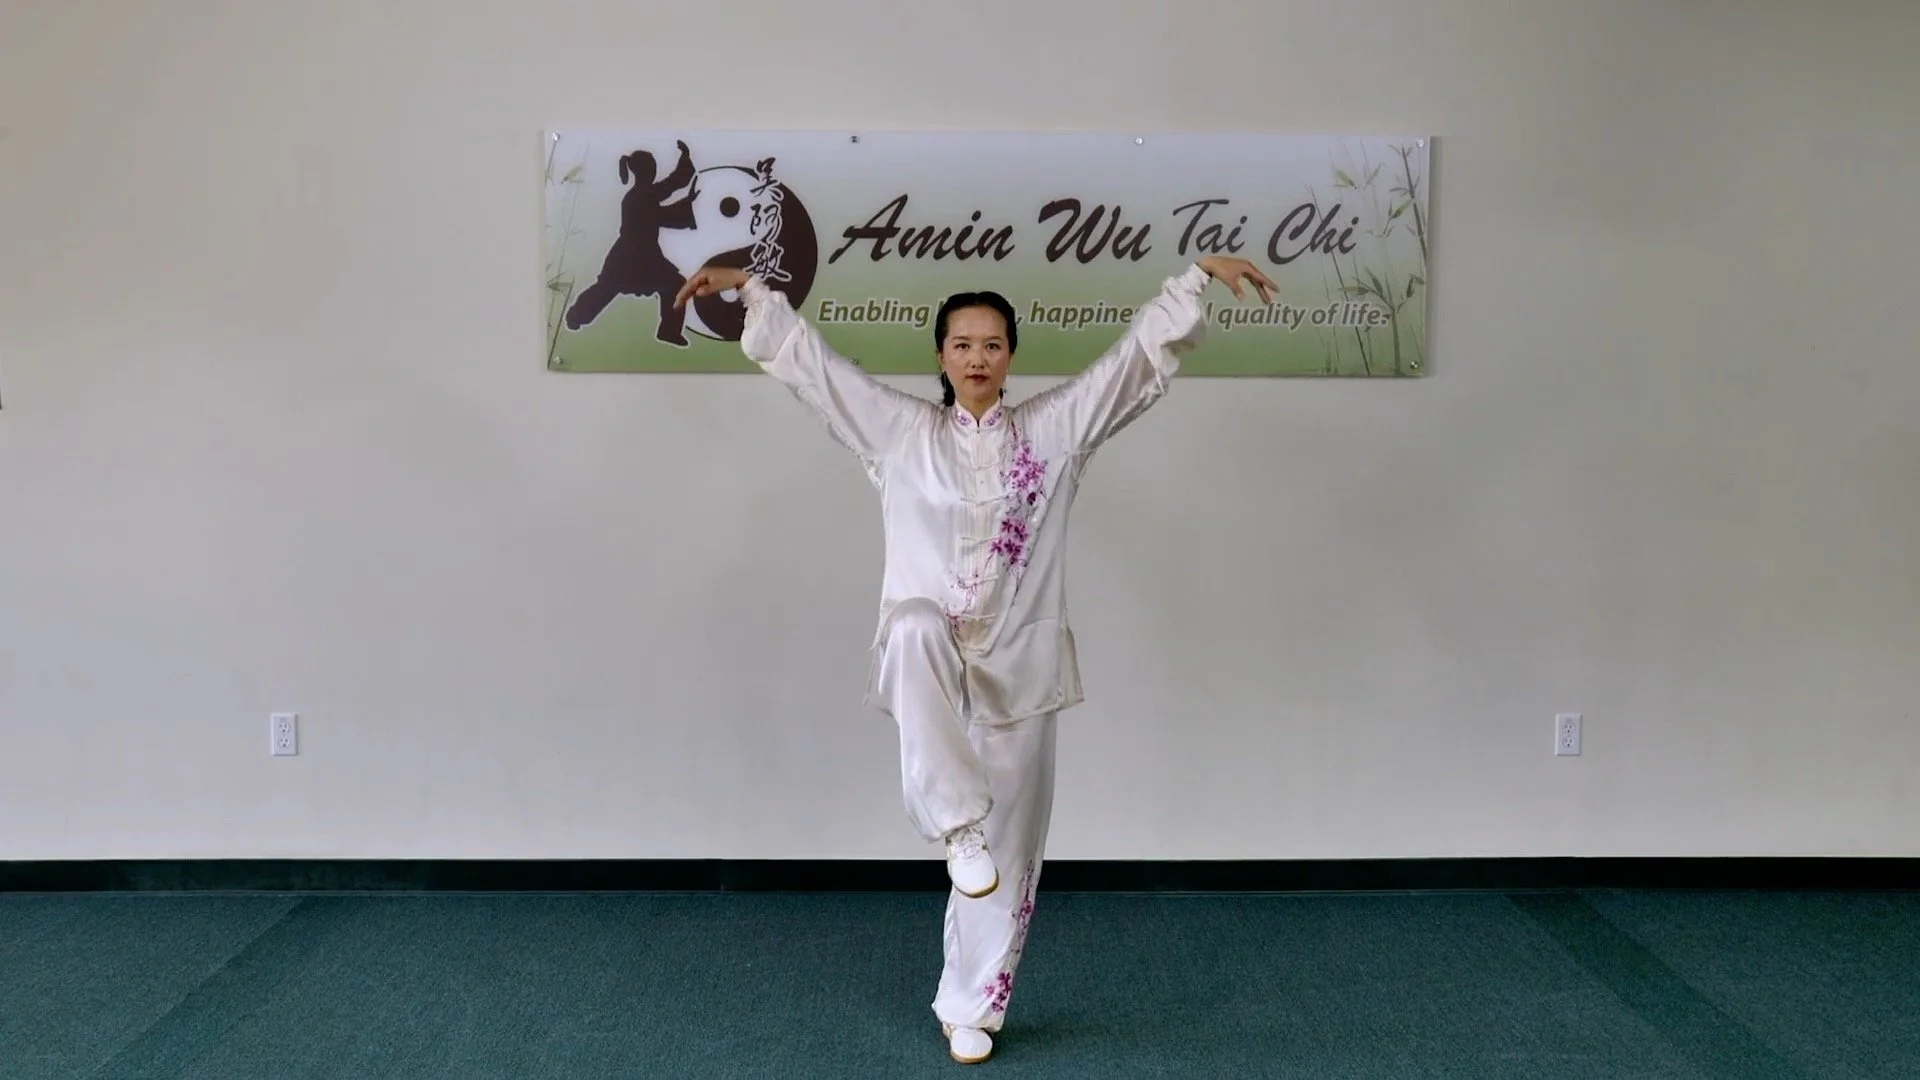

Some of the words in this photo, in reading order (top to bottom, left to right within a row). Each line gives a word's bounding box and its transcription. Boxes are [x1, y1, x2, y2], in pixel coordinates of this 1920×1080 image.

[828, 193, 1015, 264] Amin
[1038, 198, 1152, 264] Wu
[1172, 198, 1248, 256] Tai
[1267, 202, 1359, 265] Chi
[818, 300, 930, 328] Enabling
[1030, 300, 1139, 328] happine
[1217, 302, 1305, 330] quality
[1311, 301, 1339, 325] of
[1342, 302, 1388, 325] life.
